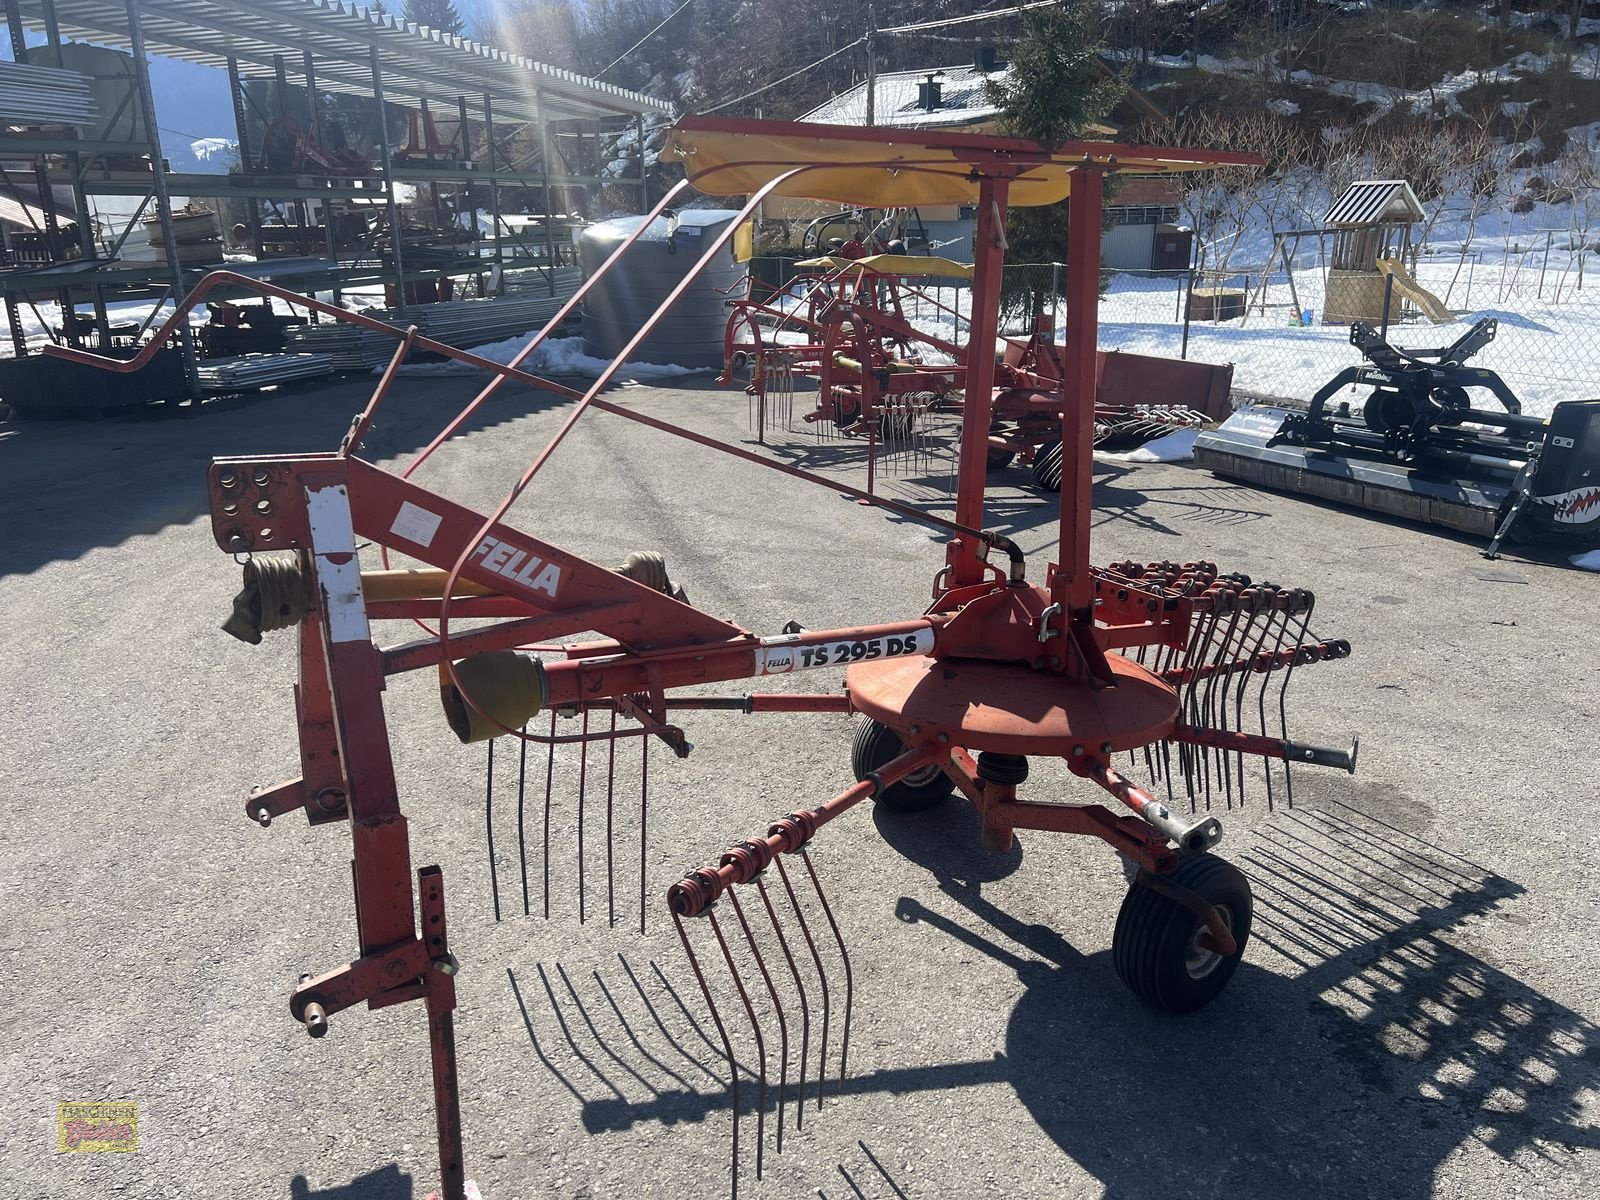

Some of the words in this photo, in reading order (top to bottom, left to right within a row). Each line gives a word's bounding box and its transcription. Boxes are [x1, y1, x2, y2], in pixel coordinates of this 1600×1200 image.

[469, 535, 561, 598] FELLA
[767, 656, 791, 668] FELLA
[801, 647, 829, 667] TS
[834, 640, 881, 664] 295
[886, 635, 917, 657] DS
